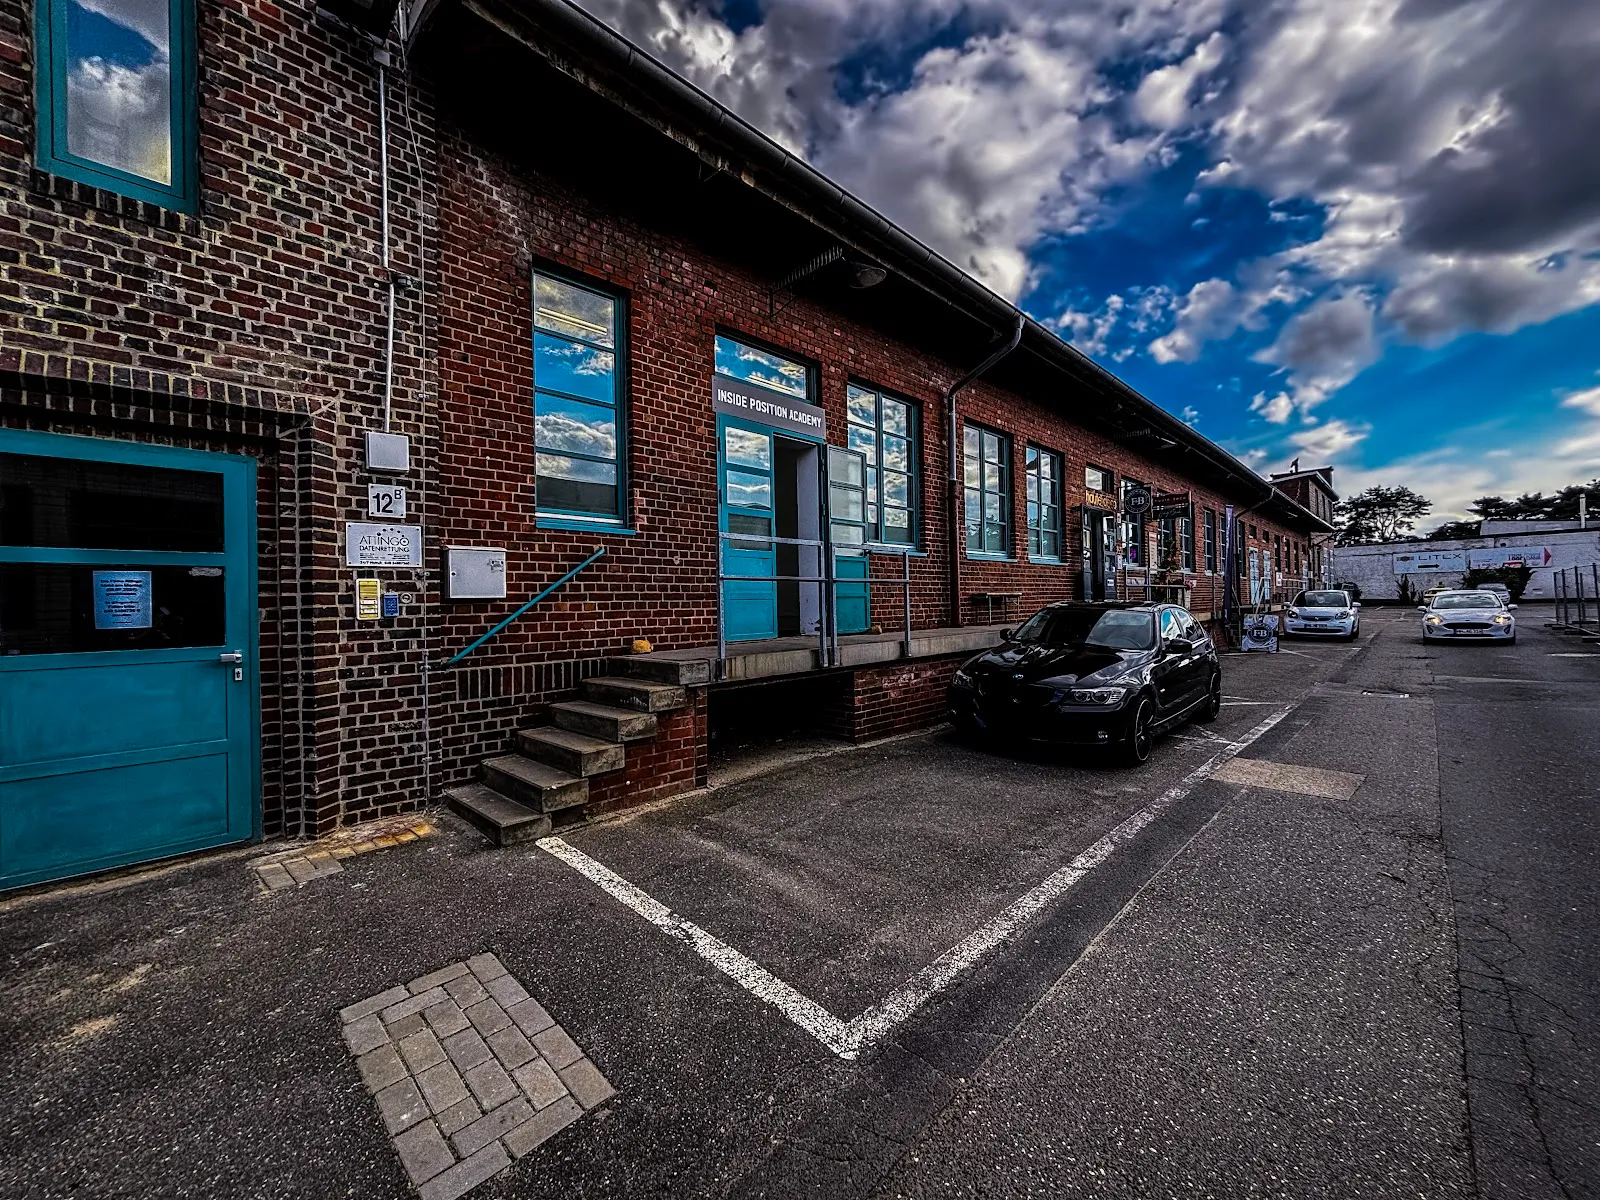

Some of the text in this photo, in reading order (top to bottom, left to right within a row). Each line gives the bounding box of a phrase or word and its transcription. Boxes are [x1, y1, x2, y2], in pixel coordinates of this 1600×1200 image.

[717, 389, 822, 428] INSIDE POSITION ACADEMY
[359, 535, 409, 546] ATTINGO
[1418, 553, 1462, 561] LITEX
